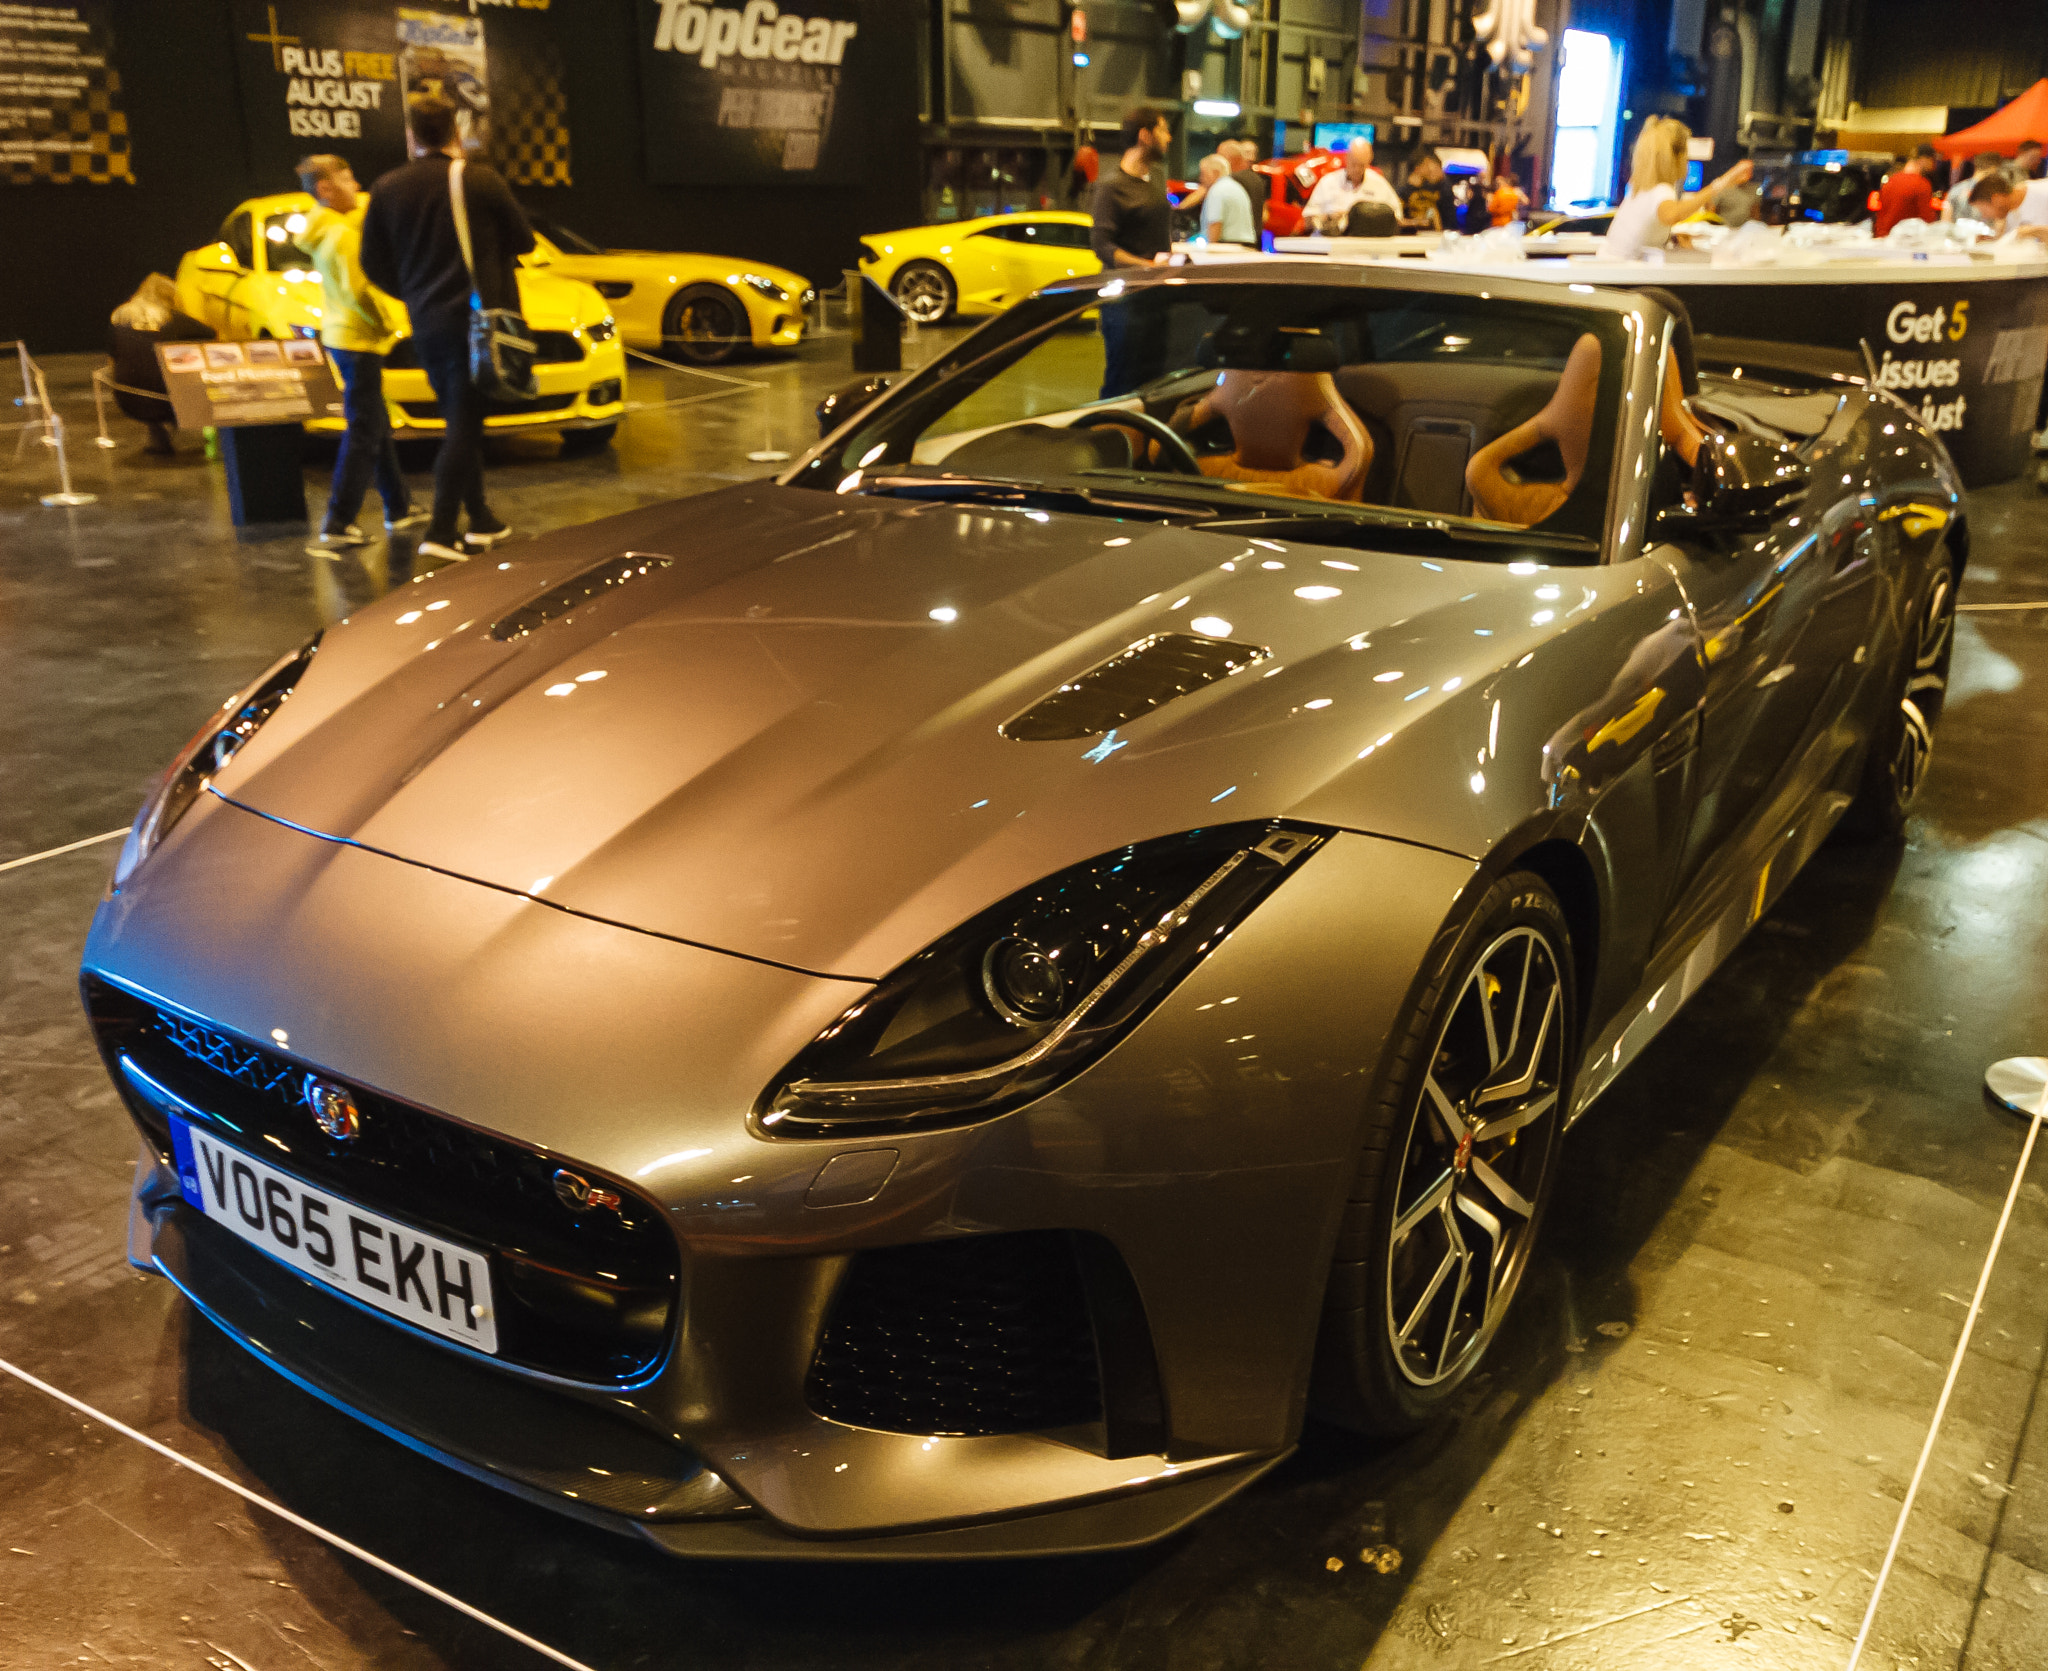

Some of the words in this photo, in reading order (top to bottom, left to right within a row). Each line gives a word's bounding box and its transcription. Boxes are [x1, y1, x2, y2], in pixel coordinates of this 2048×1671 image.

[654, 0, 857, 68] TopGear
[282, 46, 344, 78] PLUS
[286, 78, 382, 110] AUGUST
[1885, 300, 1947, 344] Get
[1948, 300, 1970, 341] 5
[1875, 350, 1961, 389] issues
[349, 1213, 478, 1331] EKH
